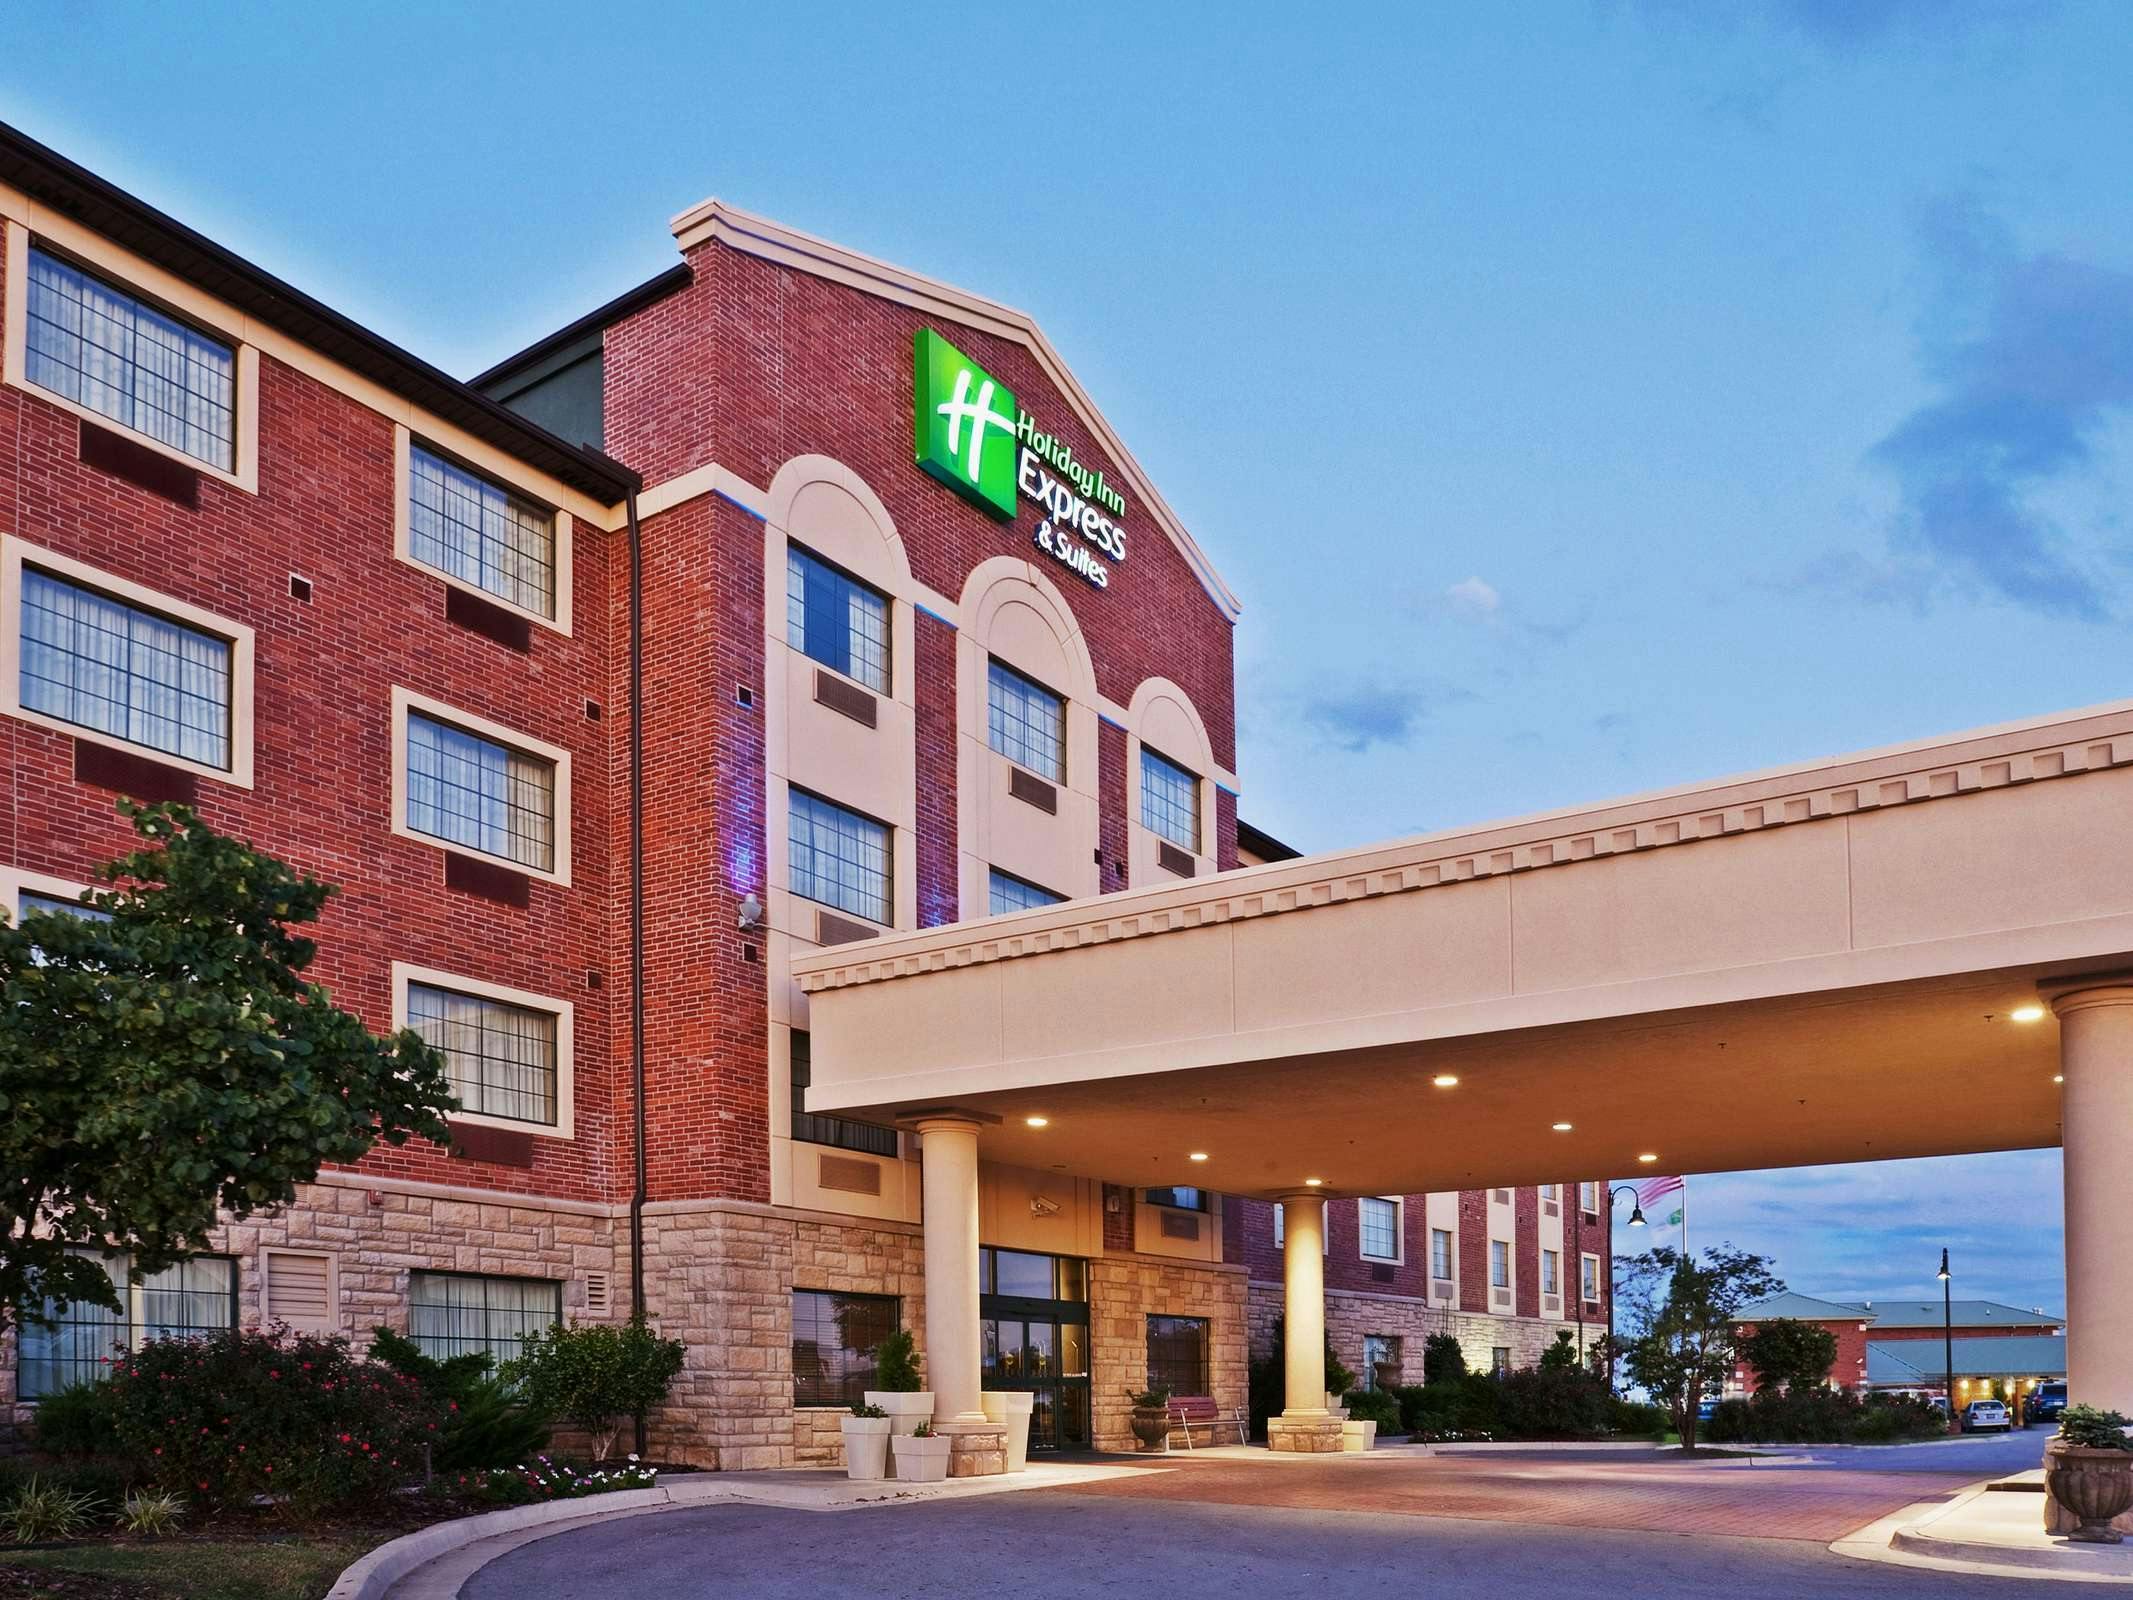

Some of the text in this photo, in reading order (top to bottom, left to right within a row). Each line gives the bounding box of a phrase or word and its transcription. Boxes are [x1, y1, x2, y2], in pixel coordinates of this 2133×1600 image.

[1017, 409, 1125, 517] Holiday Inn
[1018, 446, 1127, 561] Express
[1038, 520, 1108, 588] & Suites
